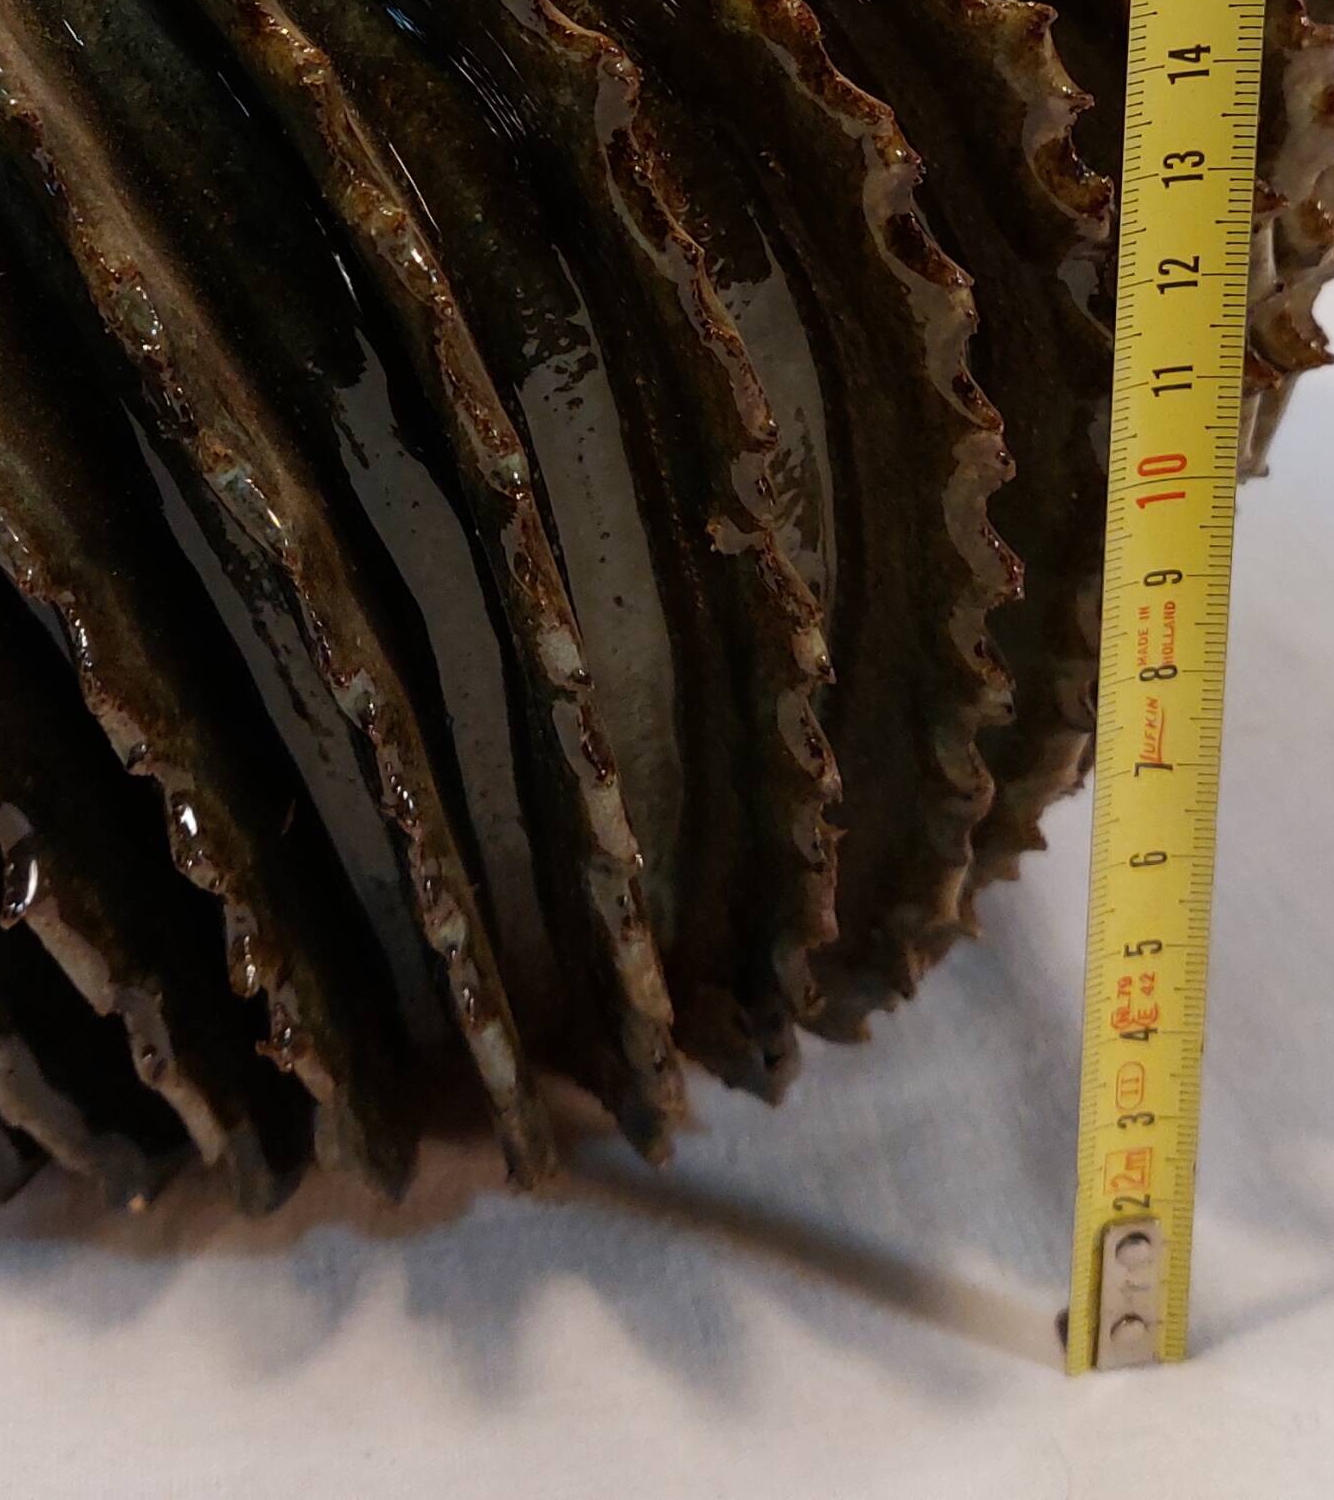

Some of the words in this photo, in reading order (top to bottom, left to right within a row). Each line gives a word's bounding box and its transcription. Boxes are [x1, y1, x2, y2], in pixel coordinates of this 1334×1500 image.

[1167, 44, 1211, 85] 14
[1162, 149, 1206, 189] 13
[1157, 255, 1200, 295] 12
[1151, 365, 1193, 397] 11
[1135, 453, 1187, 510] 10
[1143, 569, 1183, 587] 9
[1139, 606, 1150, 621] IN
[1162, 601, 1176, 666] HOLLAND
[1137, 627, 1150, 667] MADE
[1139, 664, 1178, 682] 8
[1139, 696, 1165, 764] LUFKIN
[1133, 762, 1173, 778] 7
[1129, 851, 1168, 868] 6
[1123, 939, 1163, 958] 5
[1119, 1028, 1158, 1043] 4
[1117, 1111, 1155, 1129] 3
[1113, 1194, 1151, 1211] 2
